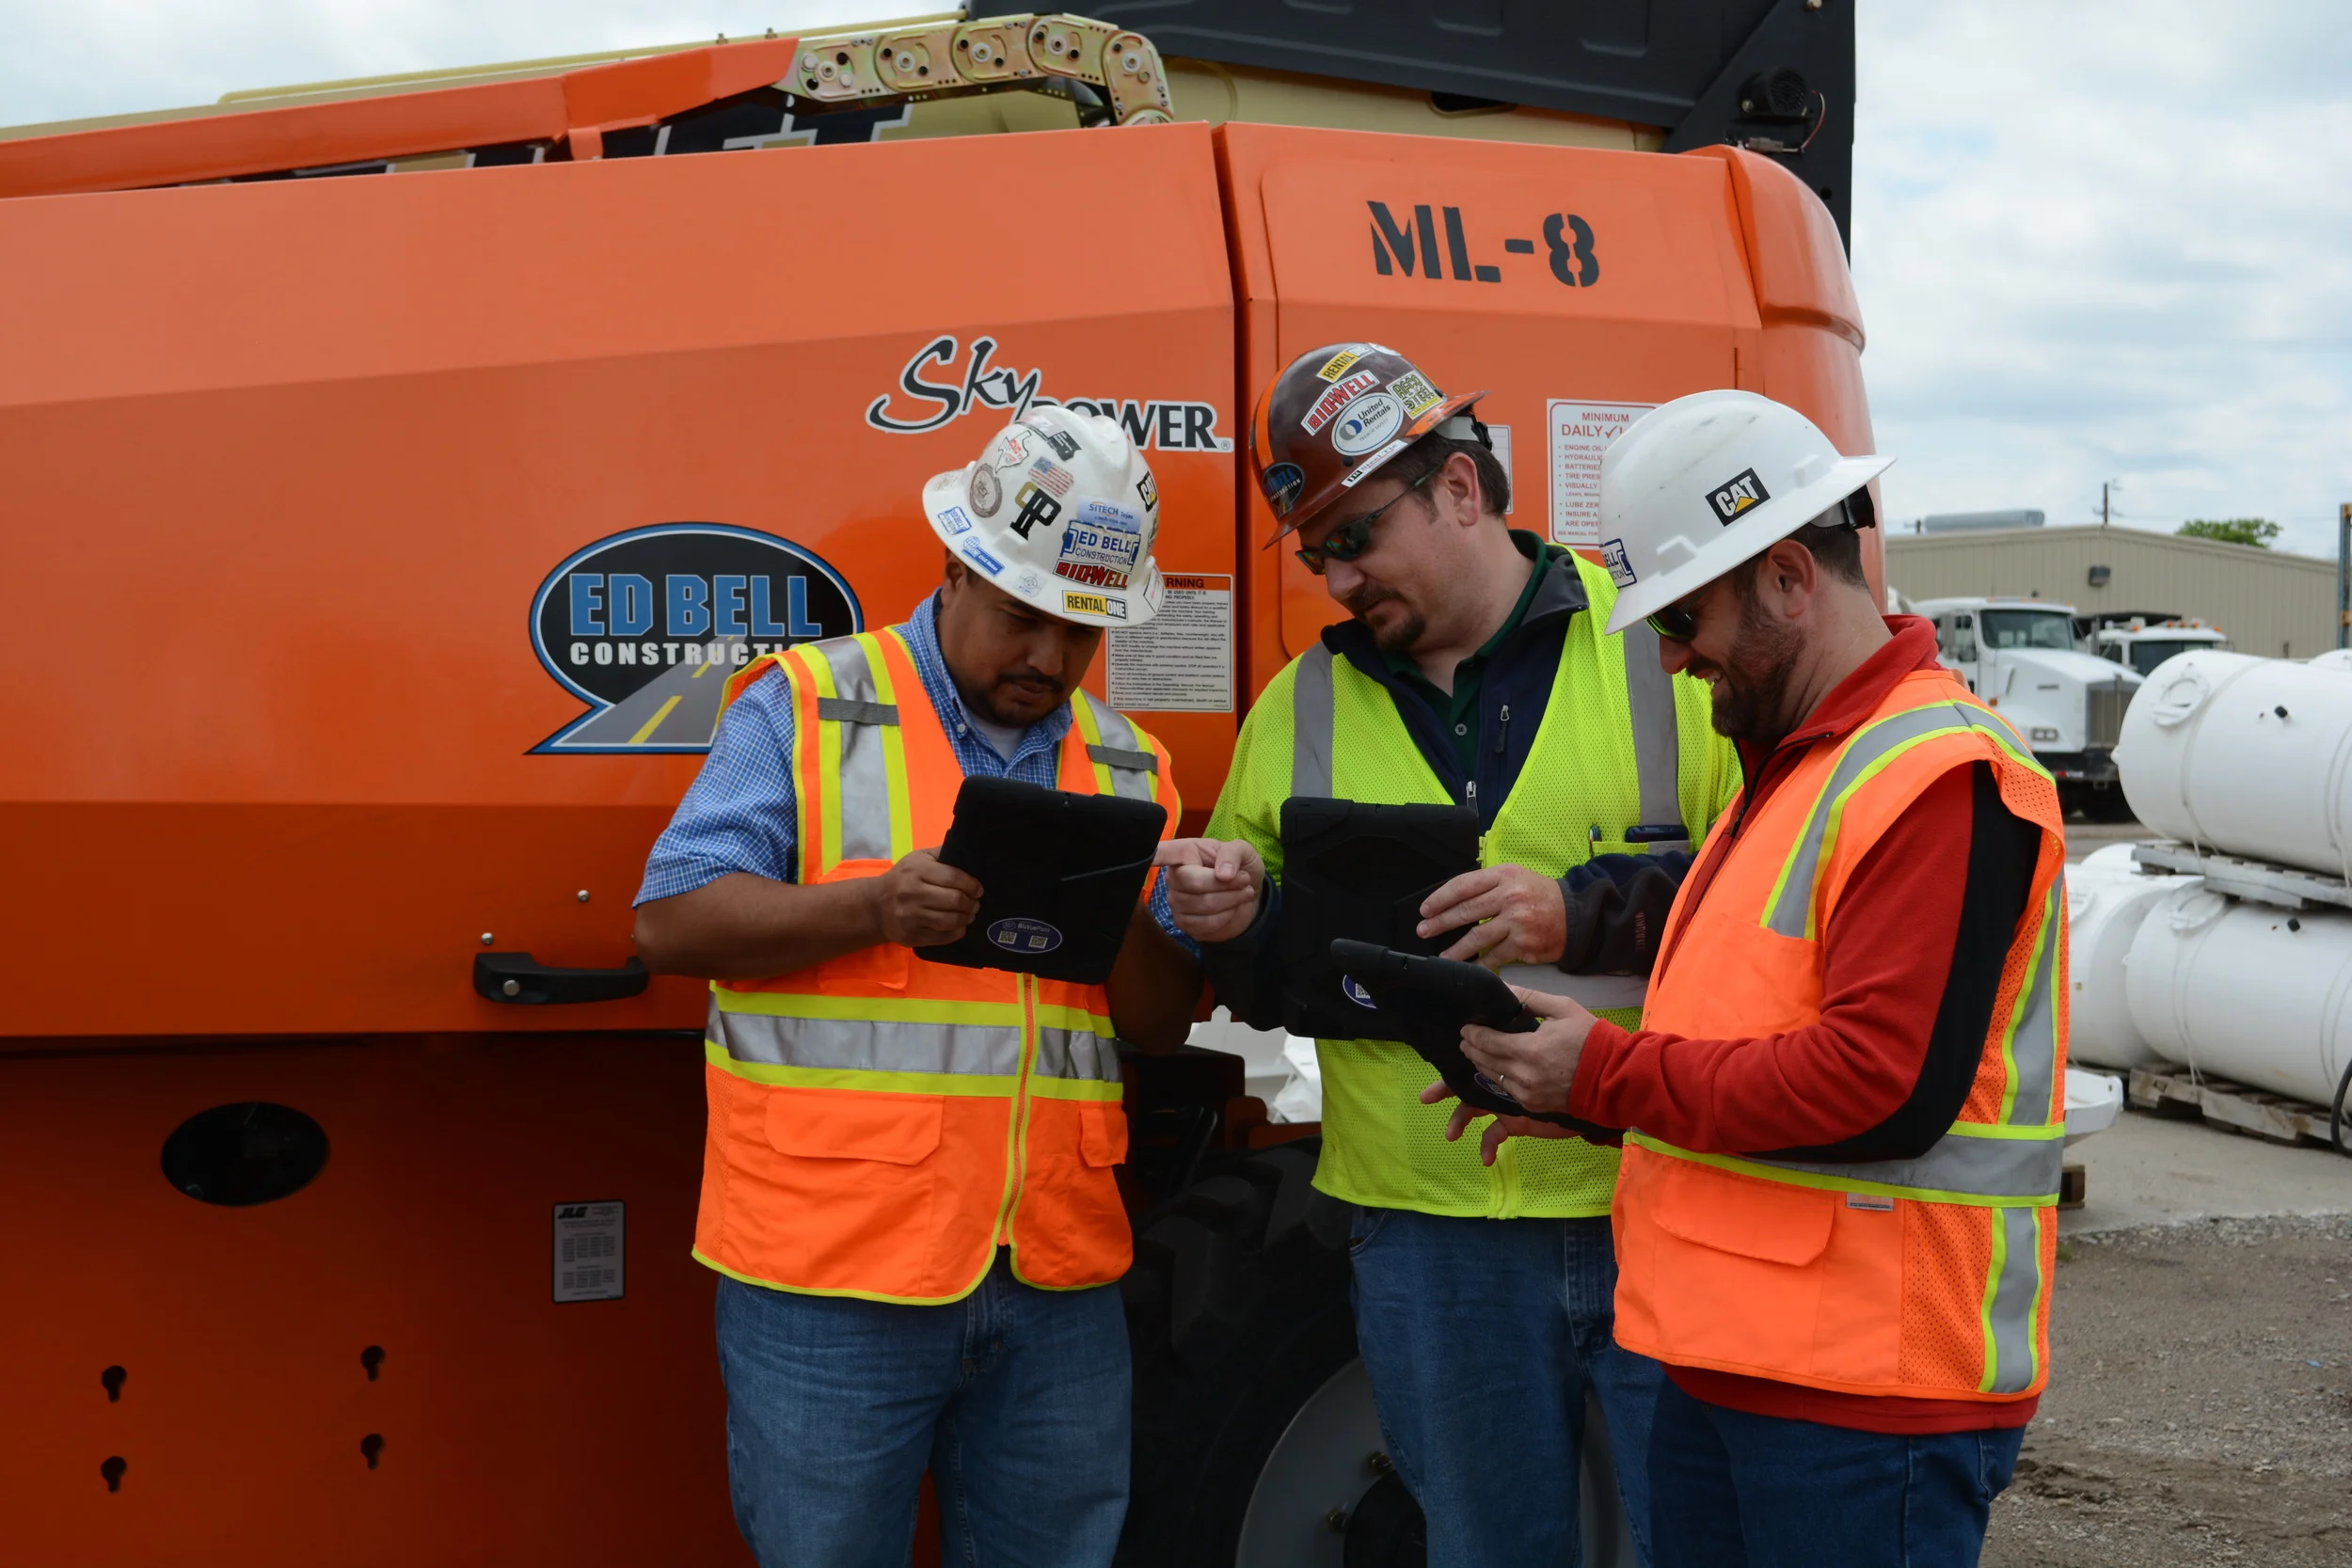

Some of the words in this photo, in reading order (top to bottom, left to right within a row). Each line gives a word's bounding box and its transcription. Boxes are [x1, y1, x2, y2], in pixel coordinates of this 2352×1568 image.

[1367, 200, 1599, 287] ML-8
[1323, 355, 1356, 379] RENTAL
[867, 337, 1040, 431] Sky
[1392, 374, 1422, 399] AFCO
[1358, 398, 1384, 420] United
[1362, 404, 1391, 427] Rentals
[1581, 412, 1629, 423] MINIMUM
[1561, 424, 1603, 437] DAILY
[1715, 475, 1759, 517] CAT
[1089, 504, 1119, 516] SITECH
[1078, 531, 1098, 546] ED
[1101, 536, 1130, 553] BELL
[1075, 547, 1128, 565] CONSTRUCTION
[1603, 552, 1619, 568] ELL
[1166, 578, 1204, 588] RNING
[569, 573, 653, 636] ED
[666, 574, 822, 637] BELL
[1067, 595, 1105, 612] RENTAL
[1107, 600, 1126, 617] ONE
